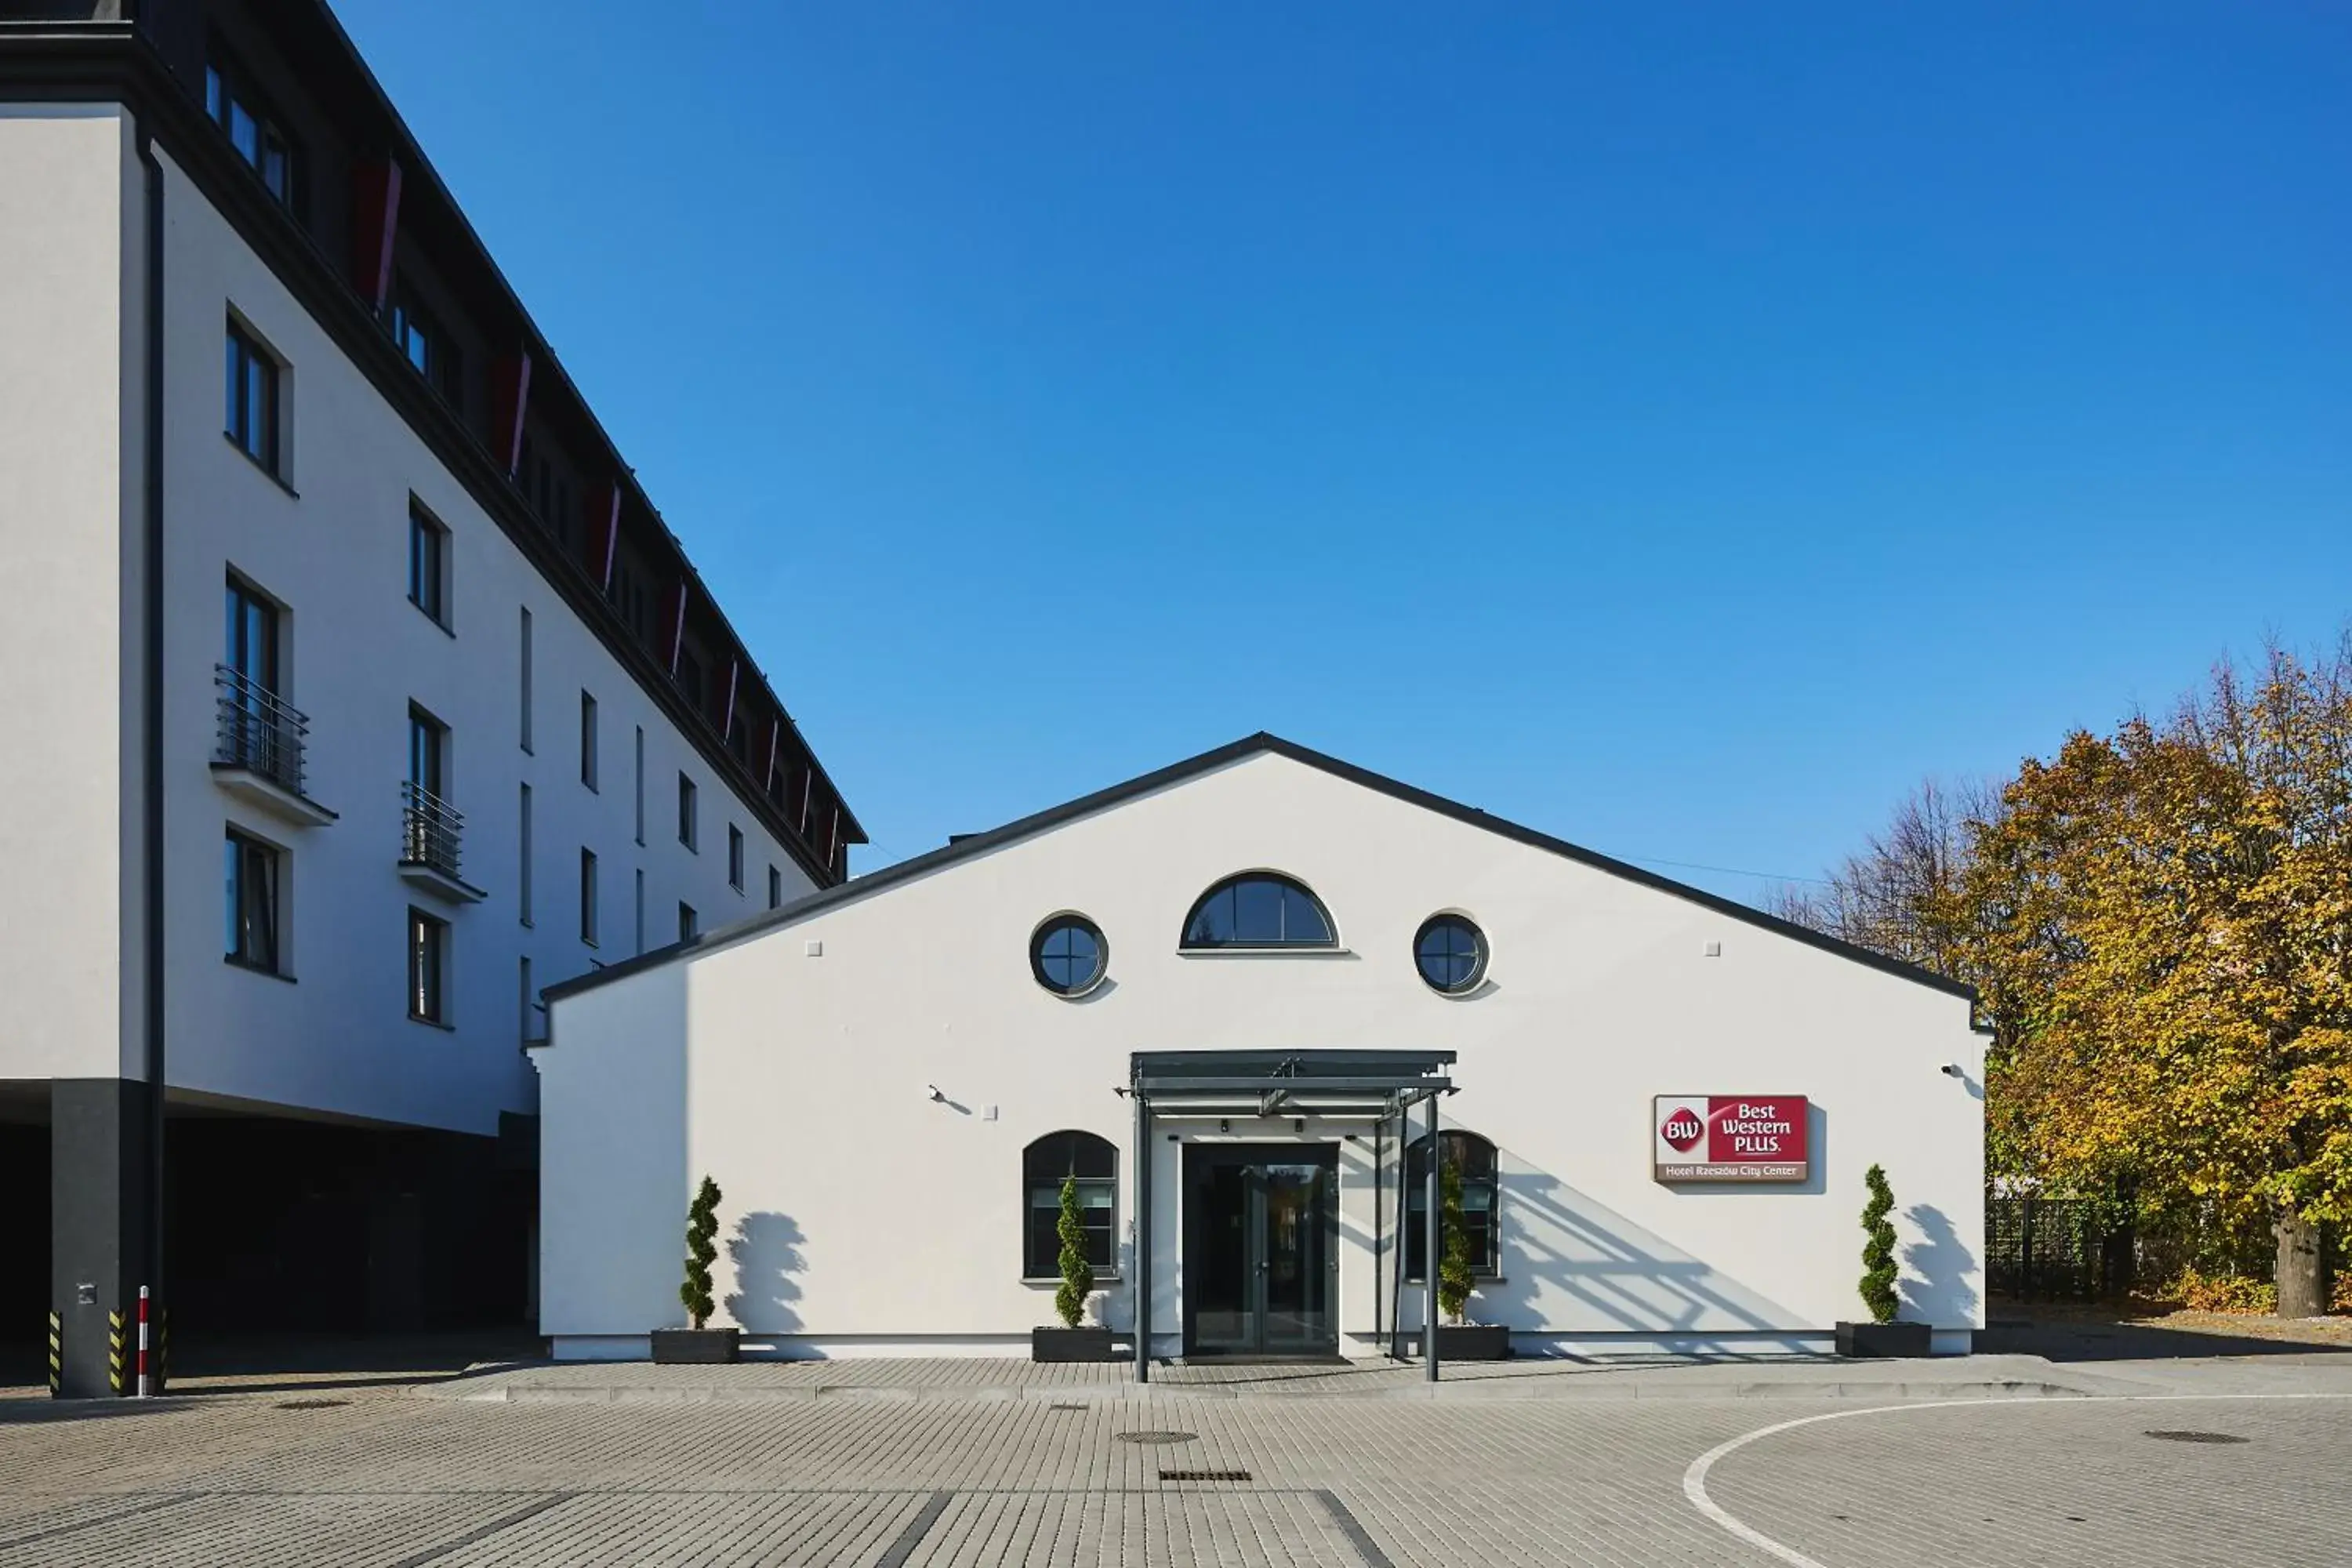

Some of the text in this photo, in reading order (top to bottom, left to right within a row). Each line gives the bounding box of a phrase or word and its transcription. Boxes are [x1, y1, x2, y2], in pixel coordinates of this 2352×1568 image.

[1738, 1103, 1776, 1119] Best
[1667, 1122, 1699, 1139] BW
[1722, 1120, 1791, 1134] Western
[1665, 1166, 1693, 1176] Hotel
[1740, 1166, 1761, 1178] City
[1763, 1166, 1797, 1176] Center
